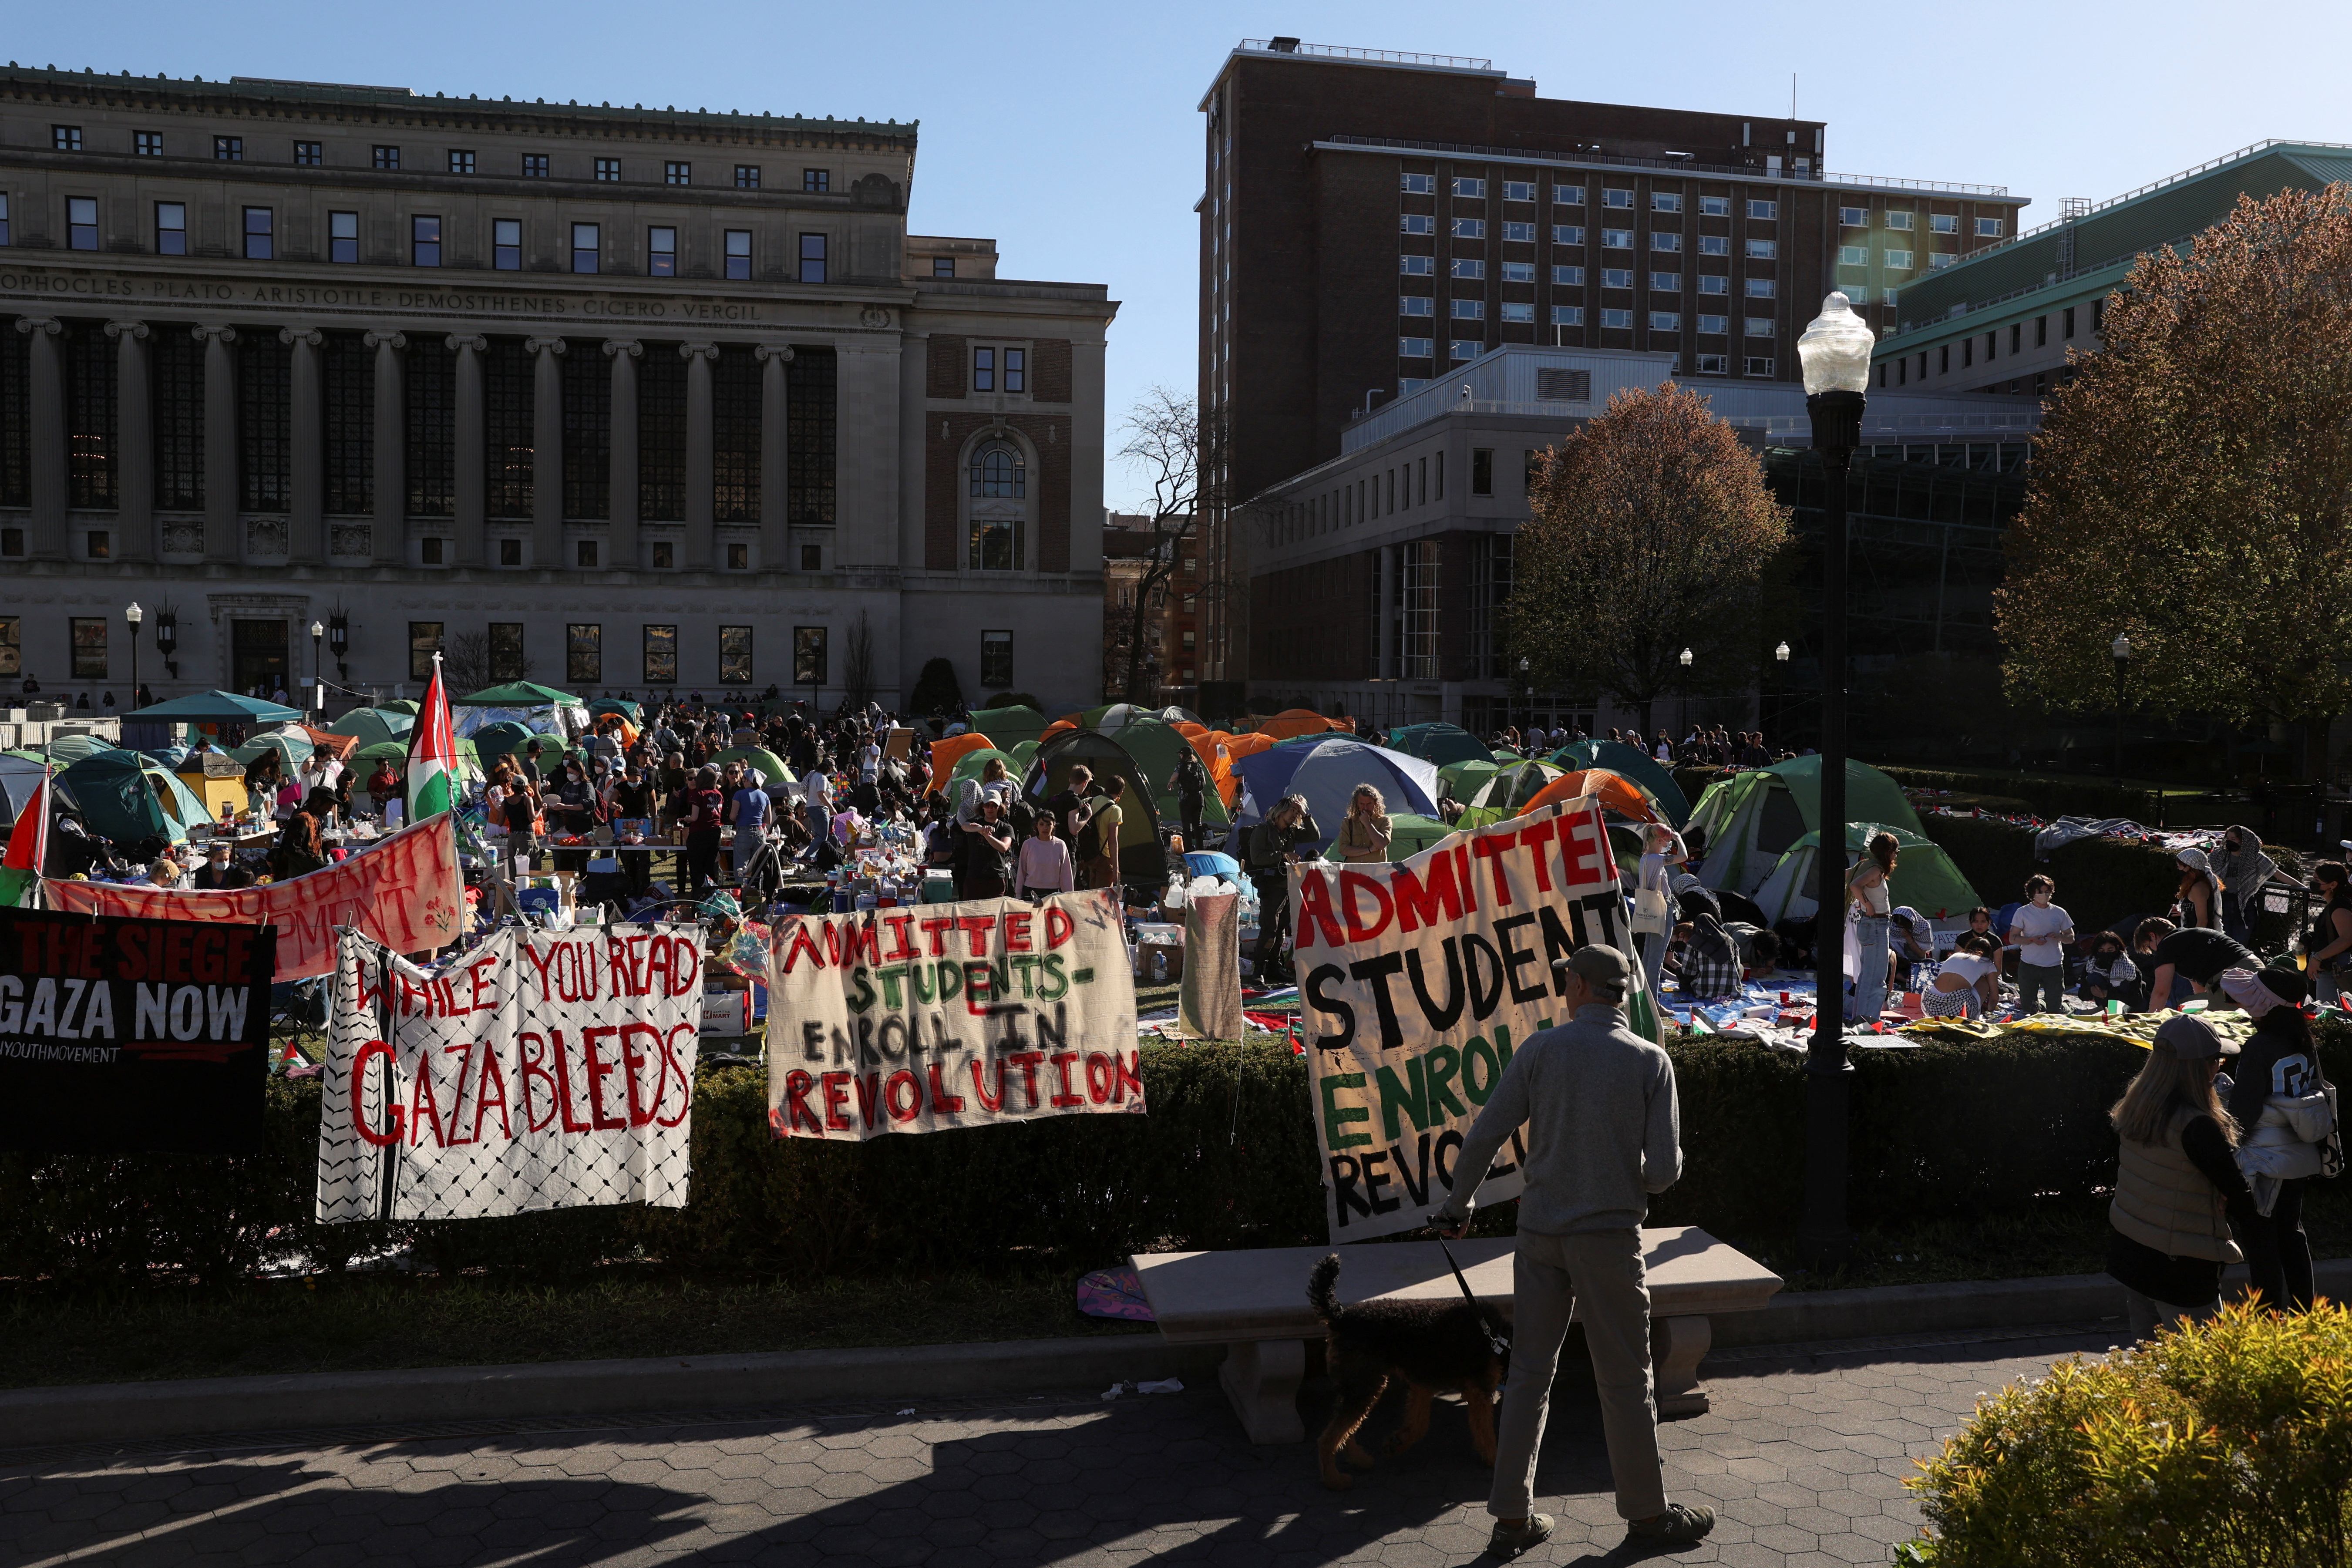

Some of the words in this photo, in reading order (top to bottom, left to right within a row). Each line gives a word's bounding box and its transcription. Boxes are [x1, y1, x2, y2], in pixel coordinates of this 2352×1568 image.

[154, 282, 232, 299] PLATO
[253, 286, 382, 306] ARISTOTLE
[398, 292, 566, 313] DEMOSTHENES
[584, 299, 665, 317] CICERO
[682, 303, 761, 320] VERGIL
[197, 816, 448, 919] SOLIDARITY
[14, 921, 107, 979] THE
[116, 924, 251, 983] SIEGE
[783, 906, 1074, 974] ADMITTED
[0, 975, 115, 1040] GAZA
[135, 982, 250, 1042] NOW
[356, 956, 498, 1018] WHILE
[524, 939, 598, 1003] YOU
[609, 934, 698, 998] READ
[802, 1009, 963, 1069] ENROLL
[985, 1001, 1068, 1050] IN
[352, 1040, 511, 1148] GAZA
[522, 1022, 697, 1133] BLEEDS
[785, 1048, 1142, 1134] REVOLUTION
